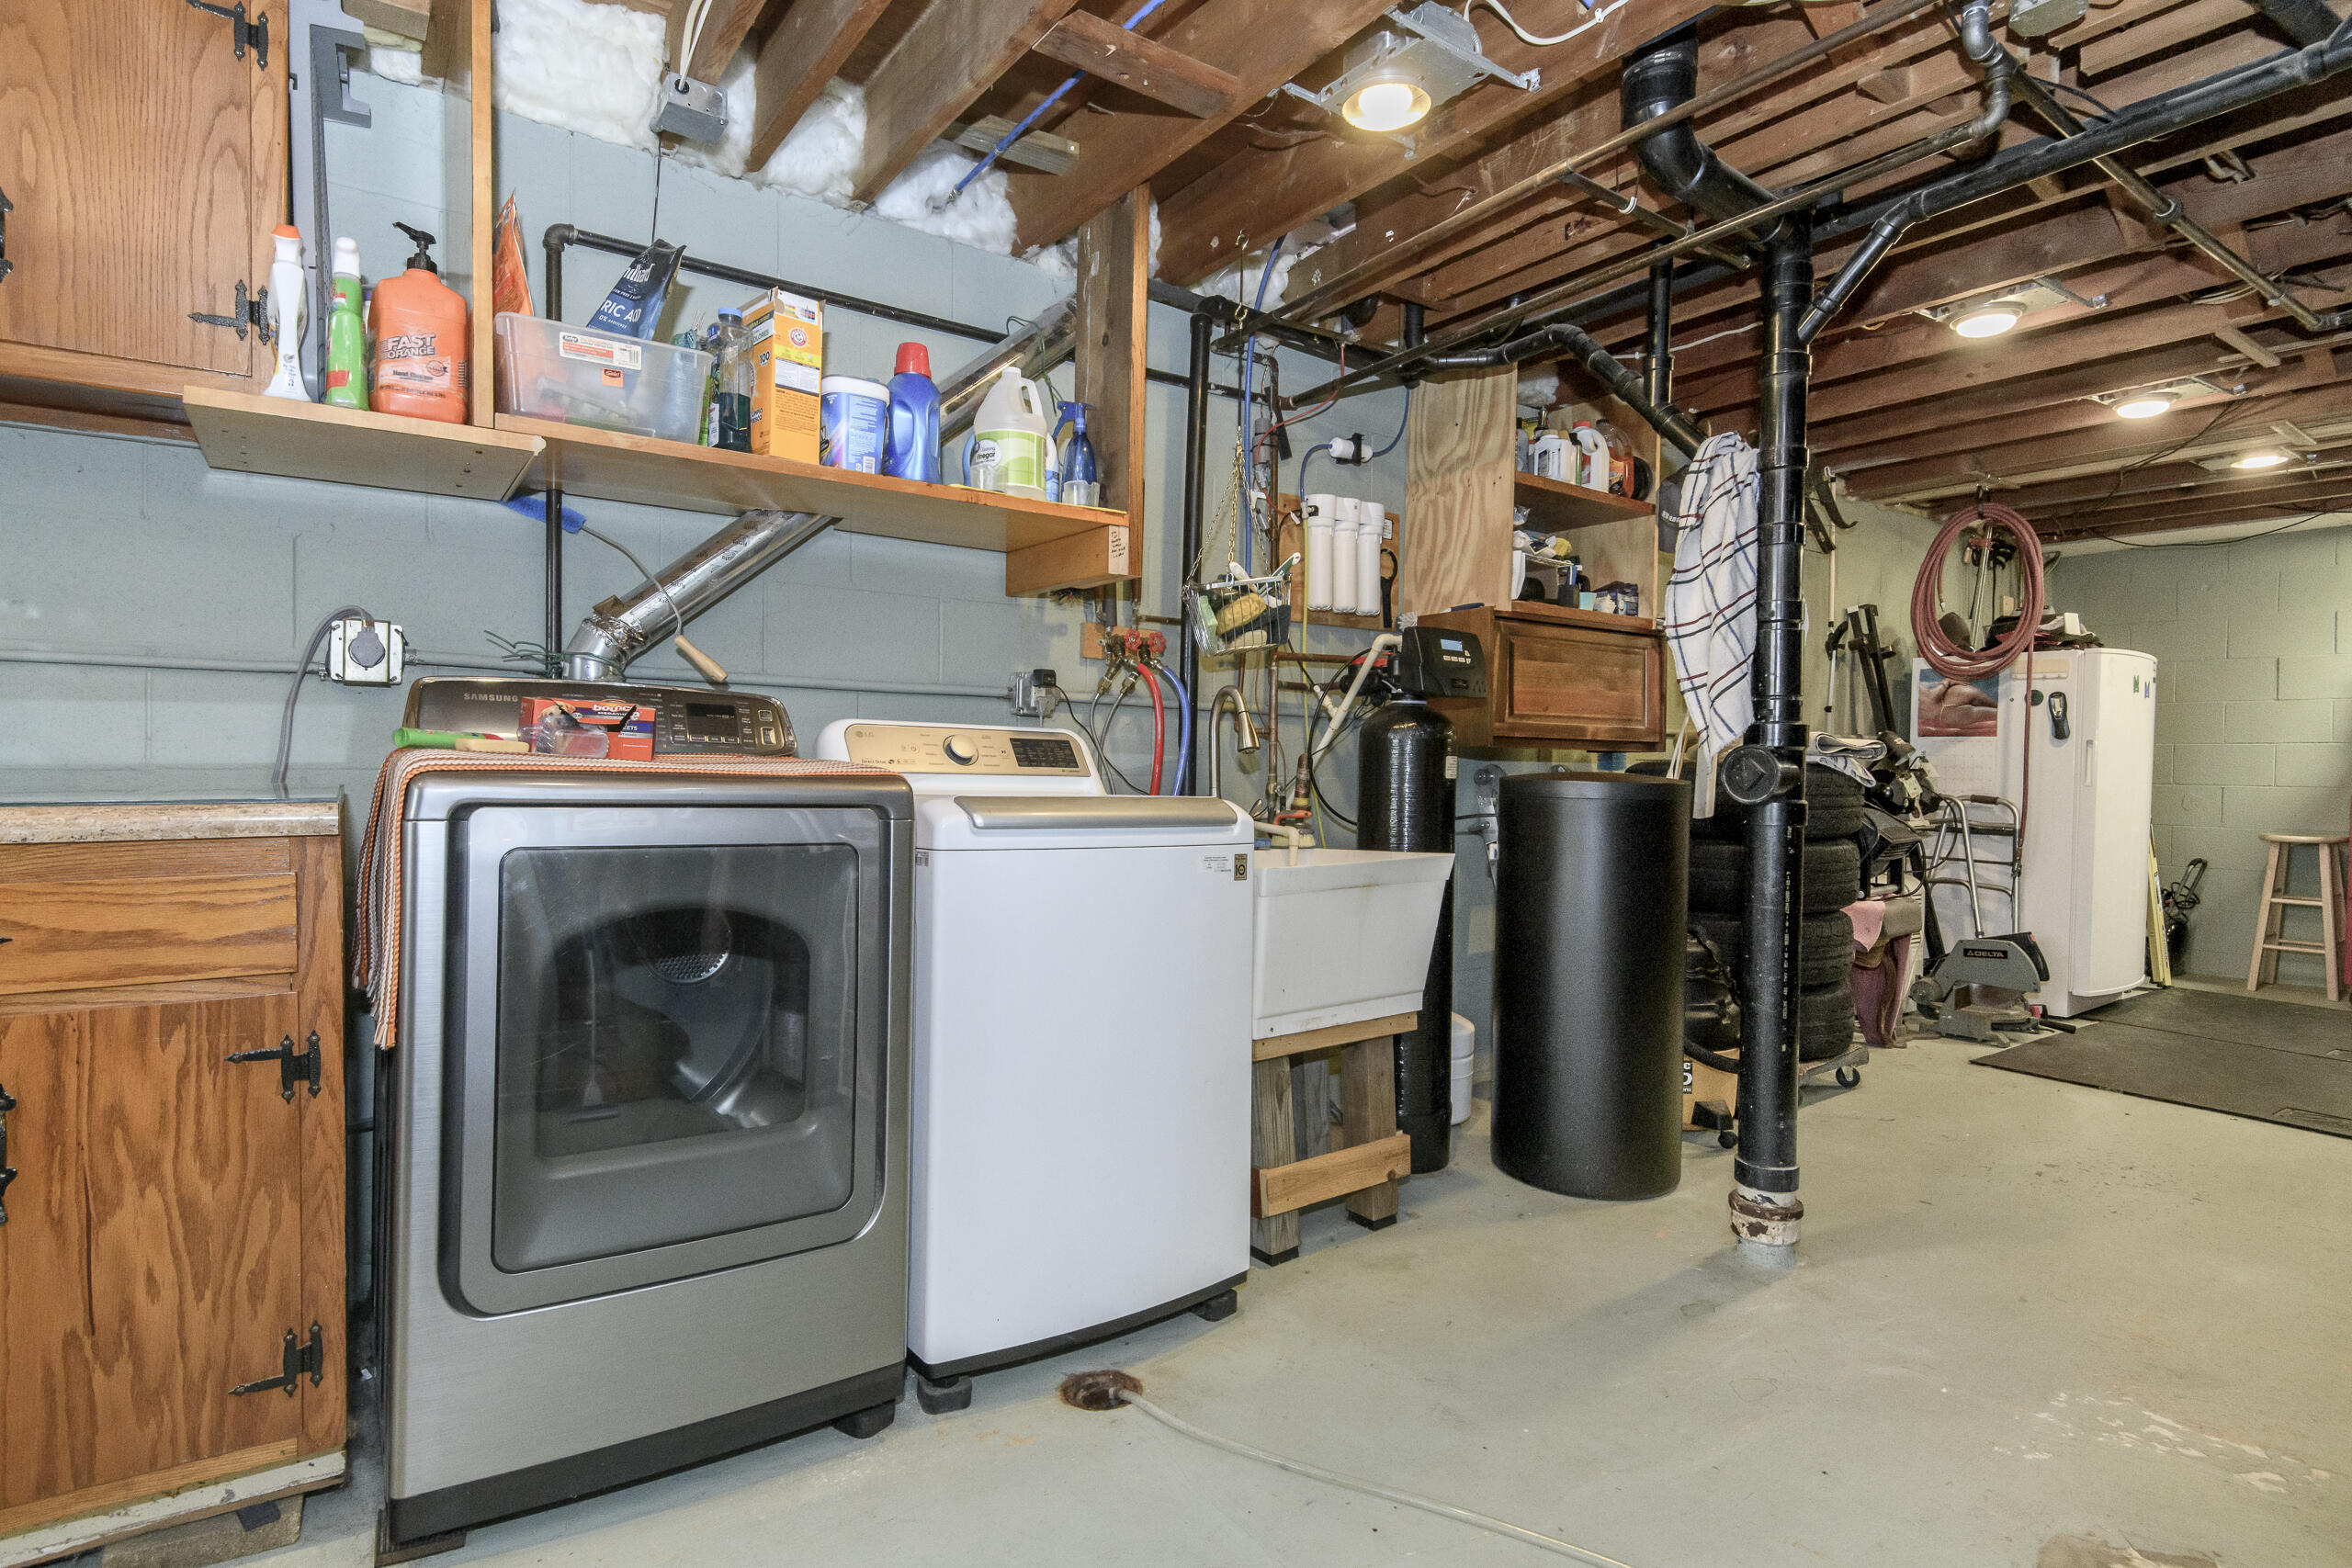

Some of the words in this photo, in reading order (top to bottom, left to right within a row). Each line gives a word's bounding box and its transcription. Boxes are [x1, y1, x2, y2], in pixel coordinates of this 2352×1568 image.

[387, 333, 436, 350] FAST
[387, 345, 435, 359] ORANGE
[759, 351, 770, 364] 100
[463, 693, 518, 702] SAMSUNG
